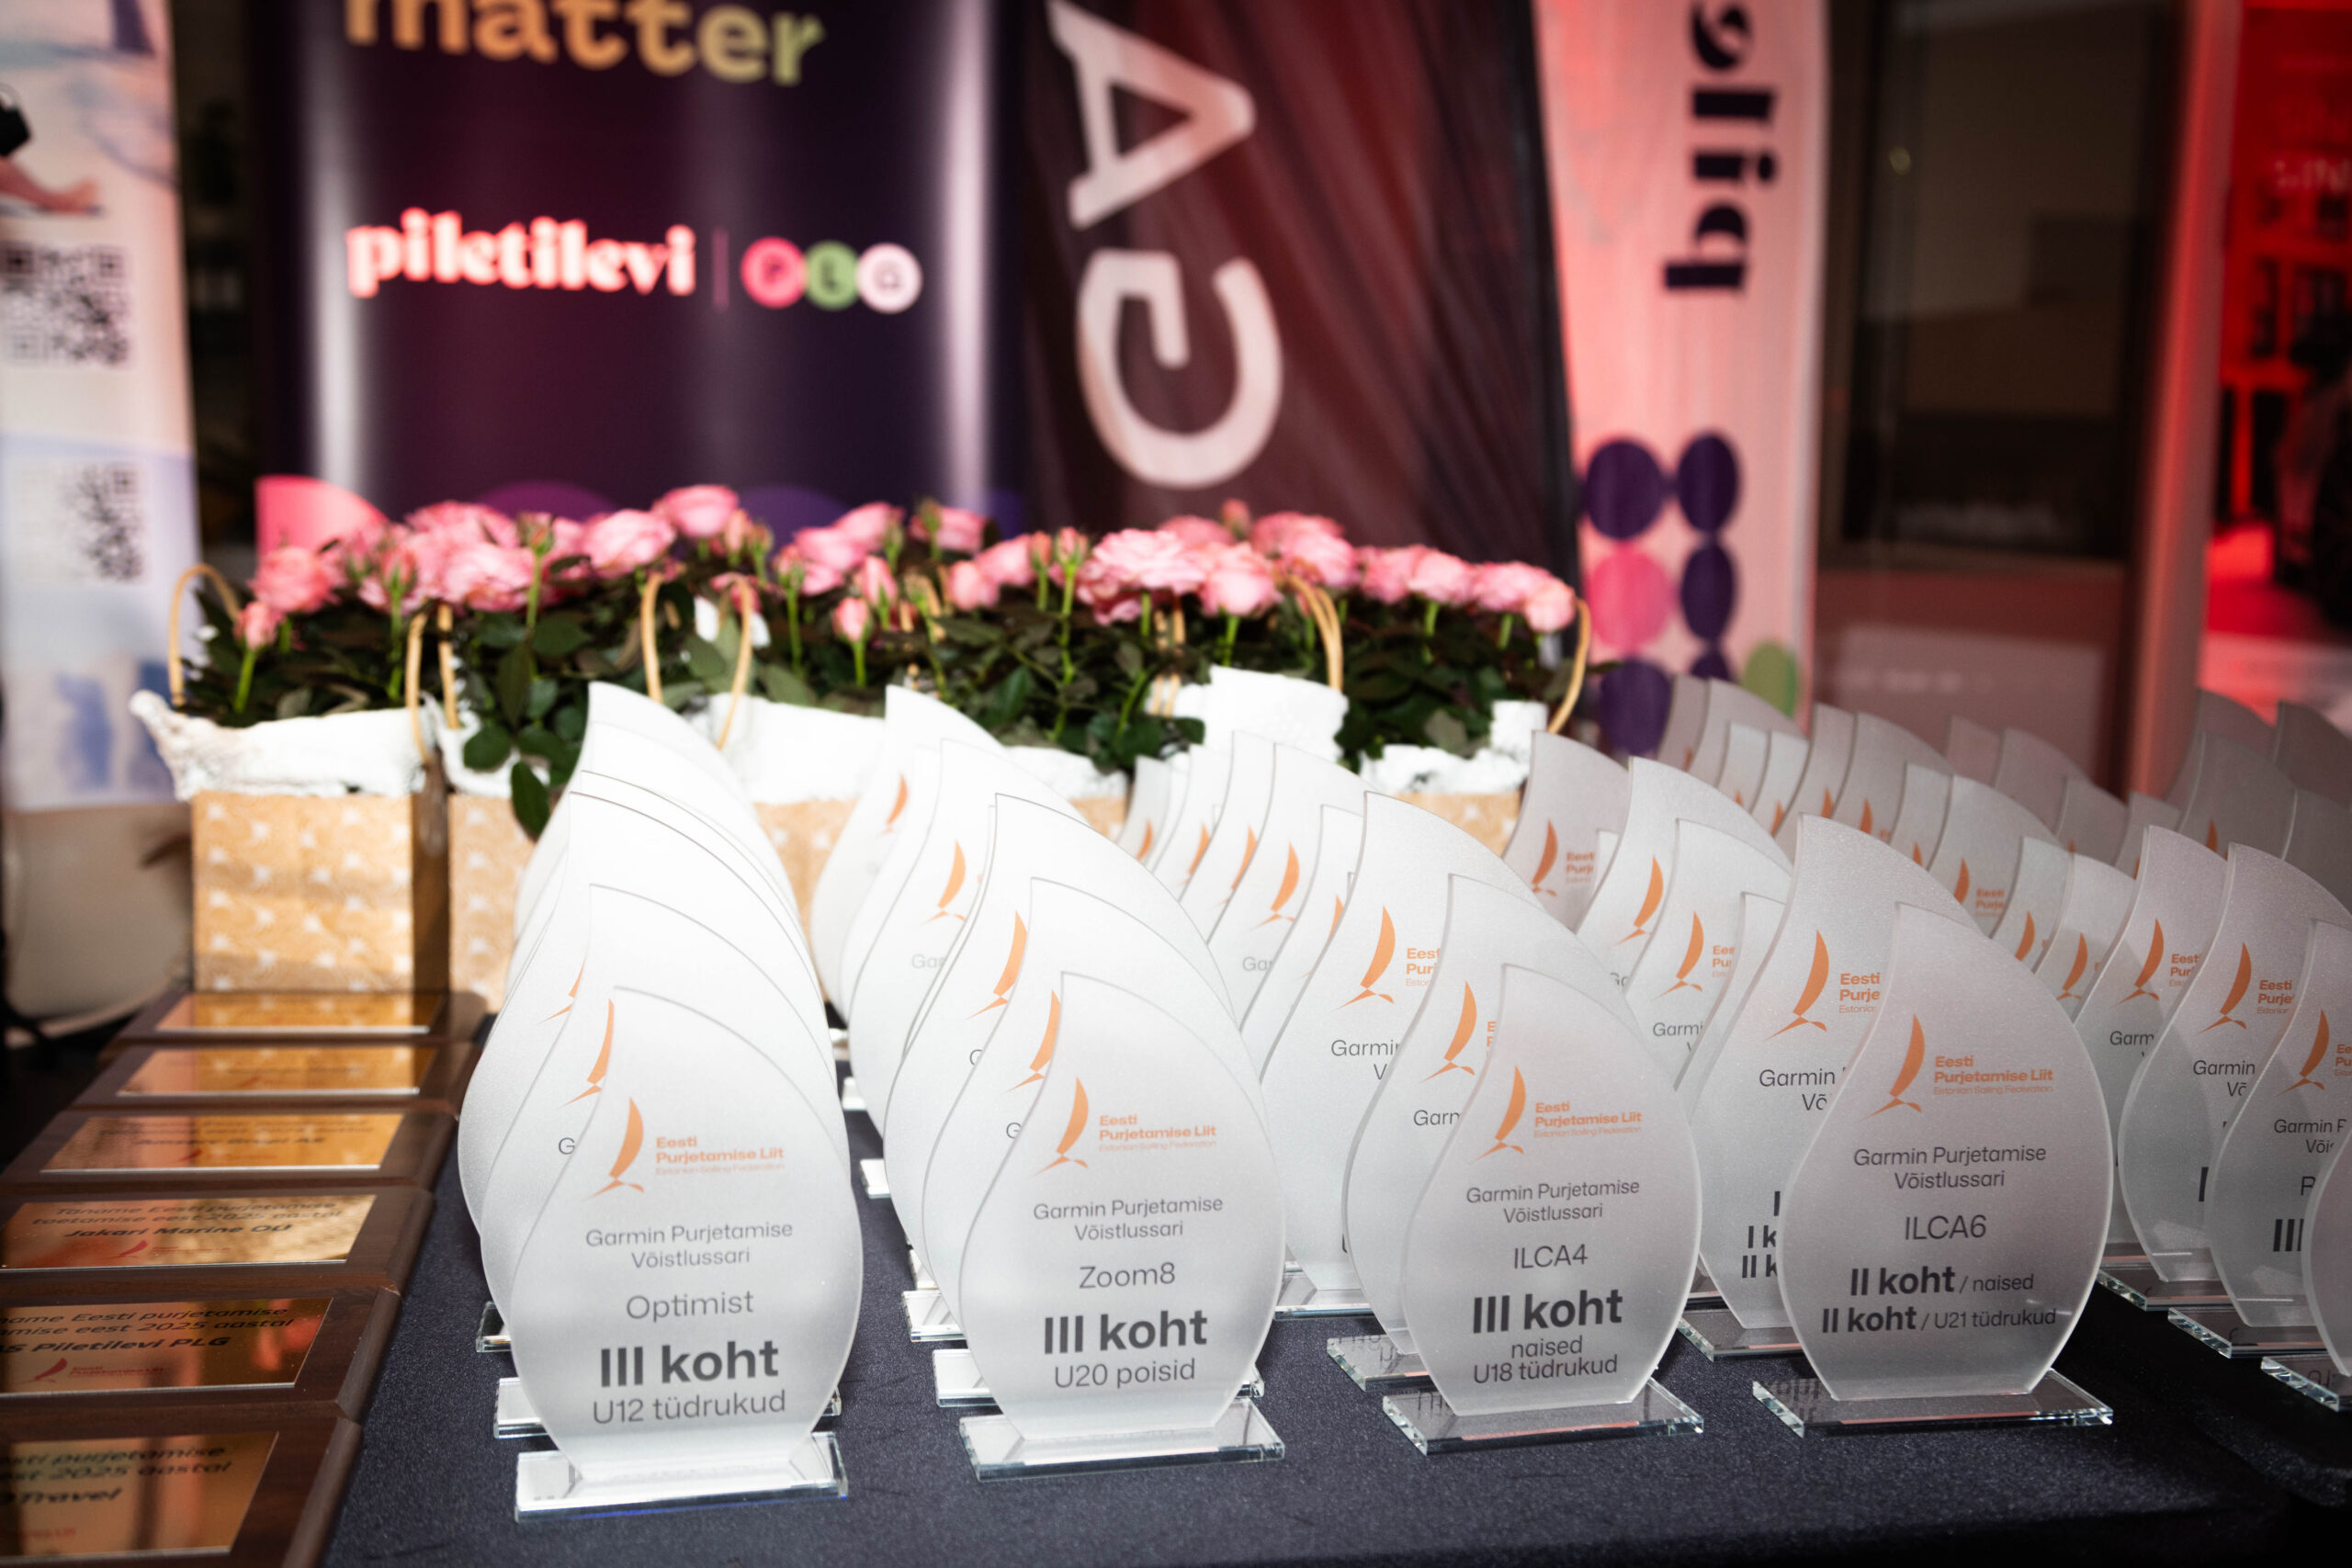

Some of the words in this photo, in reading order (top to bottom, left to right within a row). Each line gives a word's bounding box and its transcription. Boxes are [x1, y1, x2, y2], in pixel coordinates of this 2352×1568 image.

[345, 0, 825, 88] matter
[346, 206, 696, 299] piletilevi
[1407, 947, 1441, 960] Eest
[1840, 972, 1881, 986] Eesti
[2258, 979, 2293, 991] Eesti
[1839, 988, 1881, 1002] Purje
[2257, 993, 2295, 1006] Purje
[2109, 1030, 2154, 1045] Garm
[1330, 1039, 1399, 1056] Garmi
[1935, 1055, 1973, 1067] Eesti
[2193, 1060, 2256, 1076] Garmin
[1759, 1067, 1836, 1087] Garmin
[1934, 1070, 2028, 1085] Purjetamise
[2030, 1068, 2053, 1081] Liit
[1535, 1100, 1570, 1113] Eesti
[1099, 1113, 1137, 1126] Eesti
[1534, 1113, 1619, 1128] Purjetamise
[1622, 1111, 1642, 1122] Liit
[2274, 1119, 2333, 1134] Garmin
[656, 1135, 697, 1148] Eesti
[1099, 1127, 1192, 1142] Purjetamise
[1194, 1125, 1216, 1137] Liit
[656, 1148, 757, 1165] Purjetamise
[760, 1147, 785, 1159] Liit
[1854, 1148, 1927, 1166] Garmin
[1933, 1145, 2047, 1167] Purjetamise
[1894, 1170, 2006, 1189] Võistlussari
[1466, 1185, 1533, 1203] Garmin
[1537, 1179, 1640, 1201] Purjetamise
[1033, 1202, 1106, 1220] Garmin
[1111, 1197, 1223, 1218] Purjetamise
[1503, 1202, 1603, 1224] Võistlussari
[63, 1228, 150, 1237] Jakari
[153, 1226, 243, 1235] Marine
[585, 1227, 665, 1247] Garmin
[671, 1222, 793, 1244] Purjetamise
[1074, 1220, 1183, 1241] Võistlussari
[1905, 1214, 1987, 1240] ILCA6
[631, 1247, 750, 1269] Võistlussari
[1514, 1244, 1588, 1269] ILCA4
[1079, 1261, 1176, 1289] Zoom8
[1850, 1268, 1869, 1296] II
[1878, 1266, 1955, 1295] koht
[1973, 1273, 2034, 1292] naised
[72, 1312, 137, 1322] Eesti
[139, 1308, 288, 1321] purjetamise
[626, 1291, 754, 1323] Optimist
[1473, 1295, 1510, 1334] III
[1523, 1289, 1623, 1330] koht
[75, 1324, 132, 1333] eest
[137, 1321, 209, 1331] 2025
[214, 1319, 295, 1329] aastal
[1822, 1308, 1838, 1333] II
[1848, 1306, 1917, 1332] koht
[1934, 1312, 1966, 1329] U21
[1972, 1308, 2057, 1327] tüdrukud
[1045, 1314, 1084, 1354] III
[1100, 1310, 1207, 1351] koht
[31, 1338, 167, 1352] Piletilevi
[169, 1337, 232, 1348] PLG
[1511, 1335, 1583, 1359] naised
[601, 1346, 643, 1387] III
[662, 1340, 778, 1383] koht
[1474, 1362, 1512, 1384] U18
[1519, 1354, 1618, 1381] tüdrukud
[1055, 1363, 1108, 1388] U20
[1116, 1358, 1195, 1389] poisid
[594, 1398, 644, 1424] U12
[652, 1389, 786, 1421] tüdrukud
[52, 1447, 226, 1466] purjetamise
[50, 1467, 128, 1480] 2025
[139, 1461, 232, 1475] aastal
